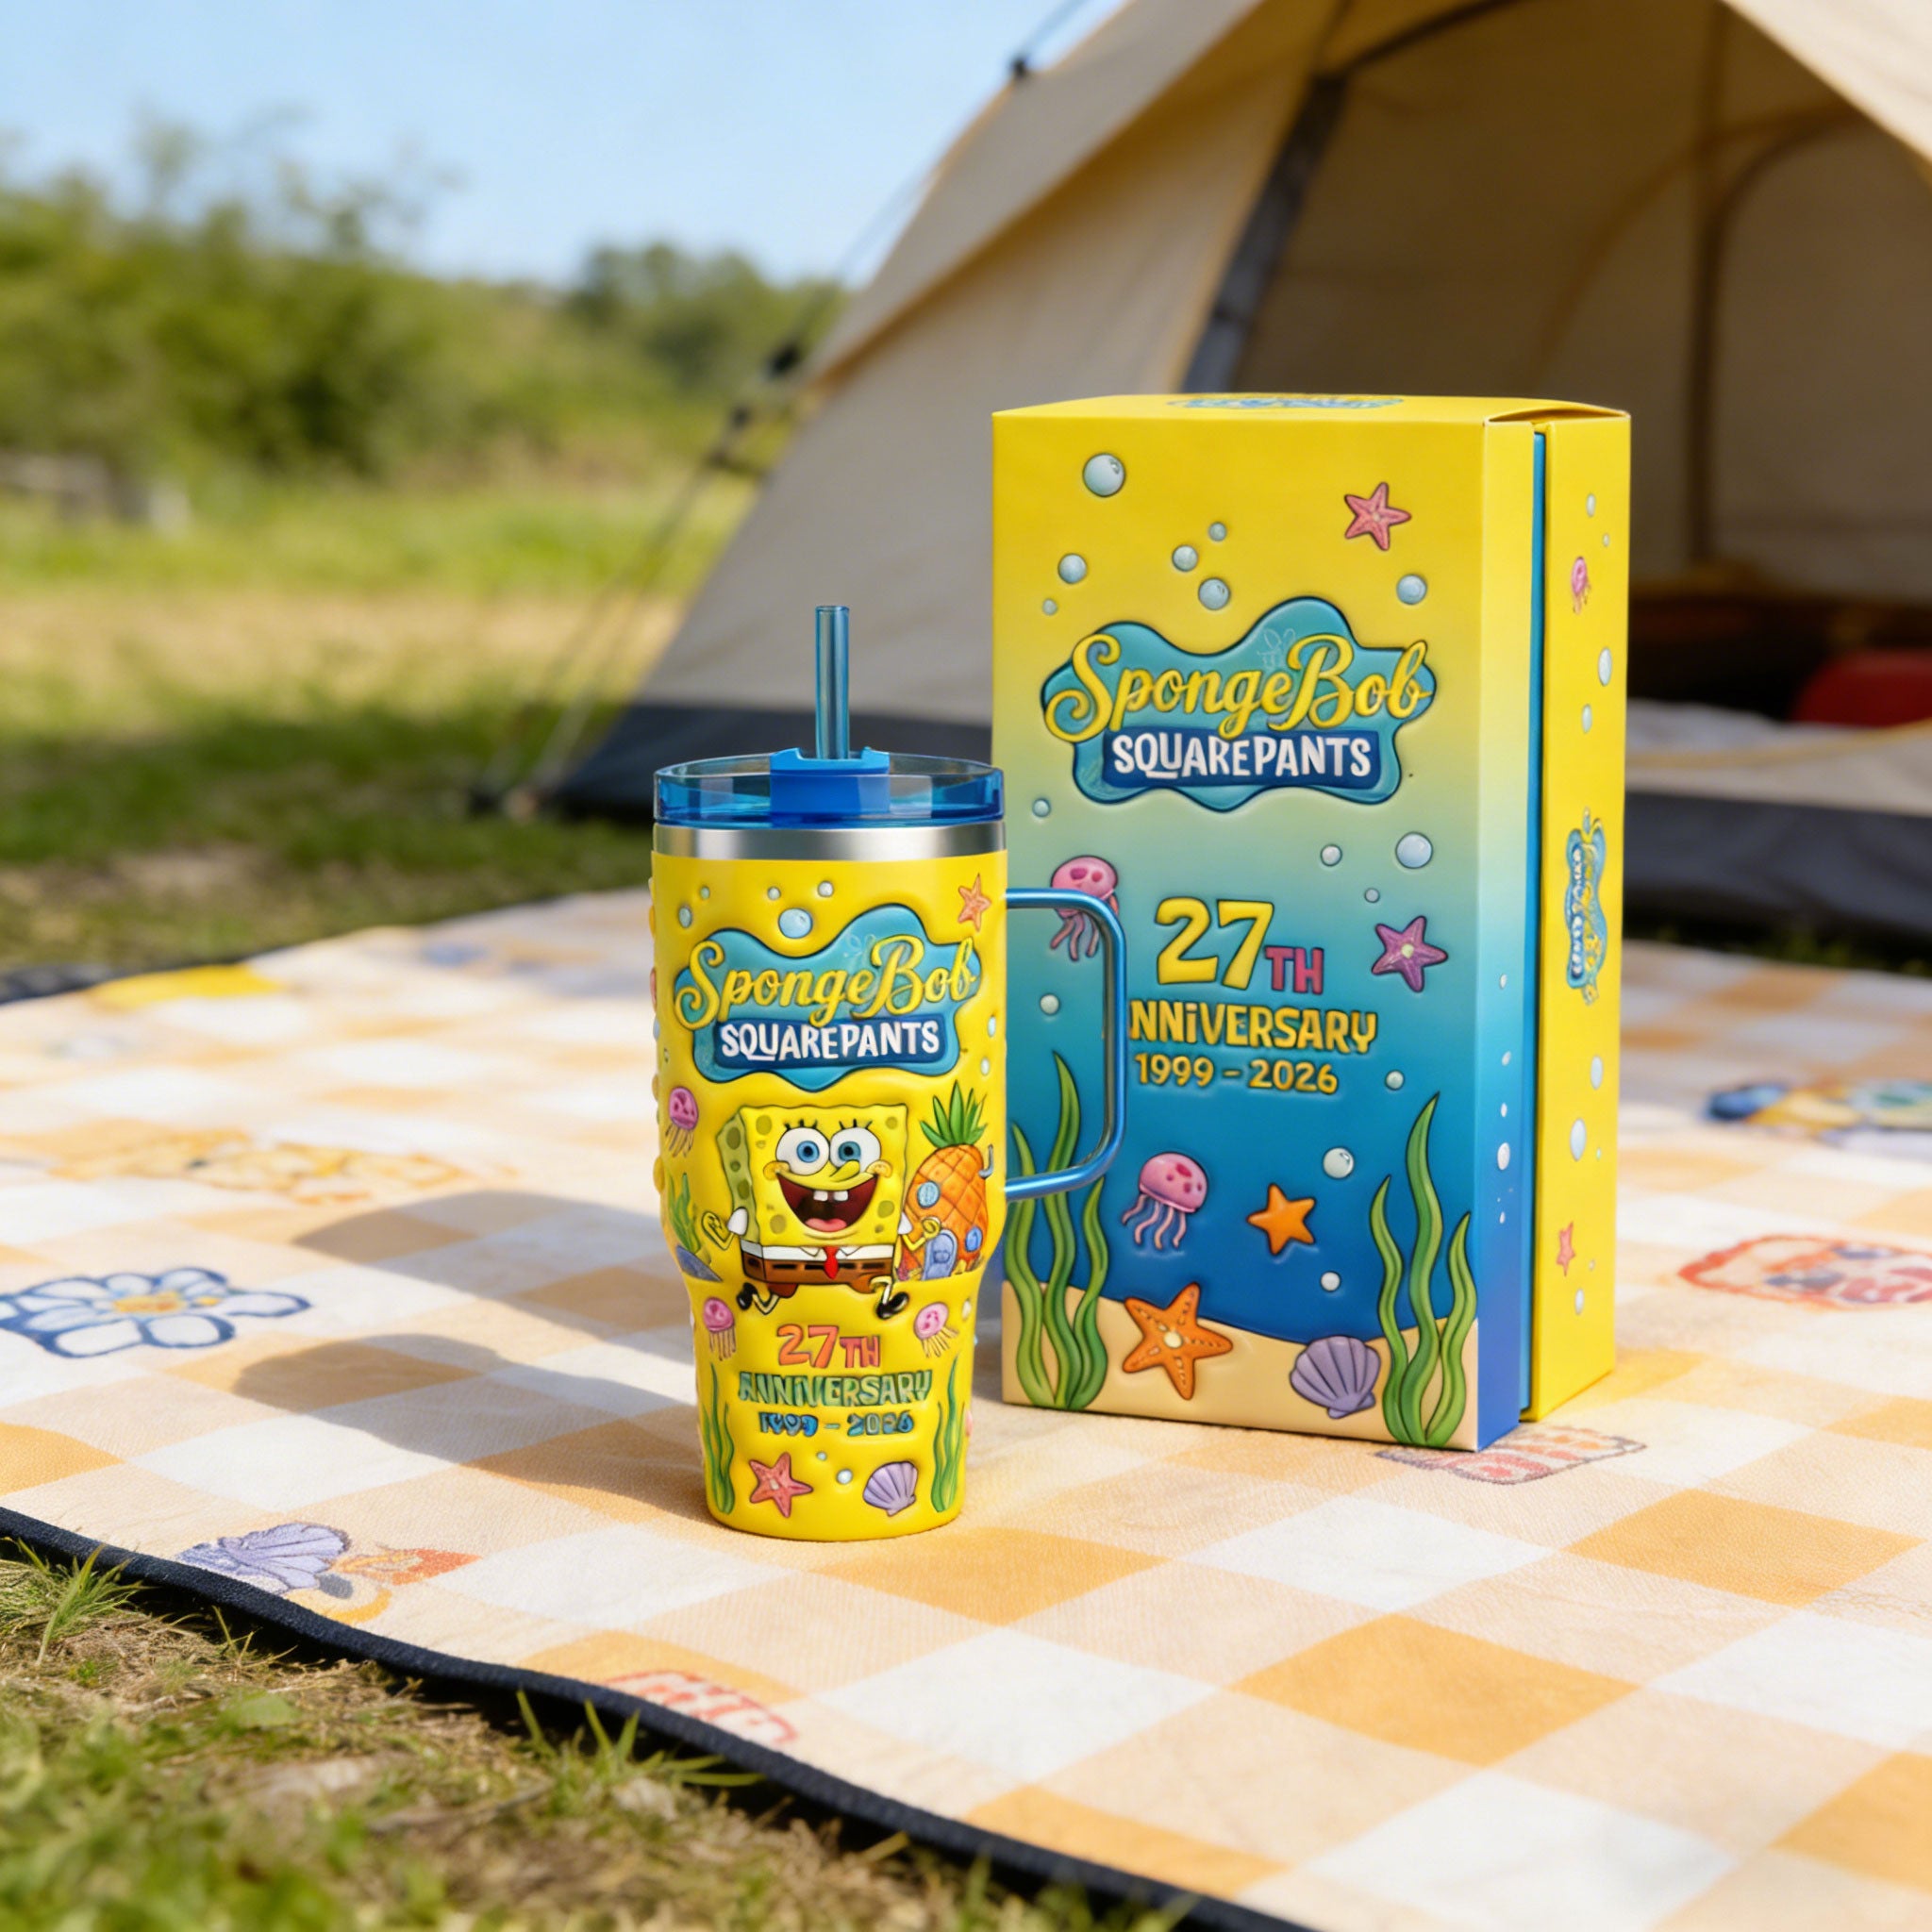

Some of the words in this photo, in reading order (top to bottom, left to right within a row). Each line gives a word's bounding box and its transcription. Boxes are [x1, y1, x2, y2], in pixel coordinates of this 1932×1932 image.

[1044, 633, 1433, 742] SpongeBob
[1111, 731, 1372, 779] SQUAREPANTS
[675, 934, 977, 1030] SpongeBob
[1155, 897, 1324, 995] 27TH
[721, 1020, 940, 1061] SQUAREPANTS
